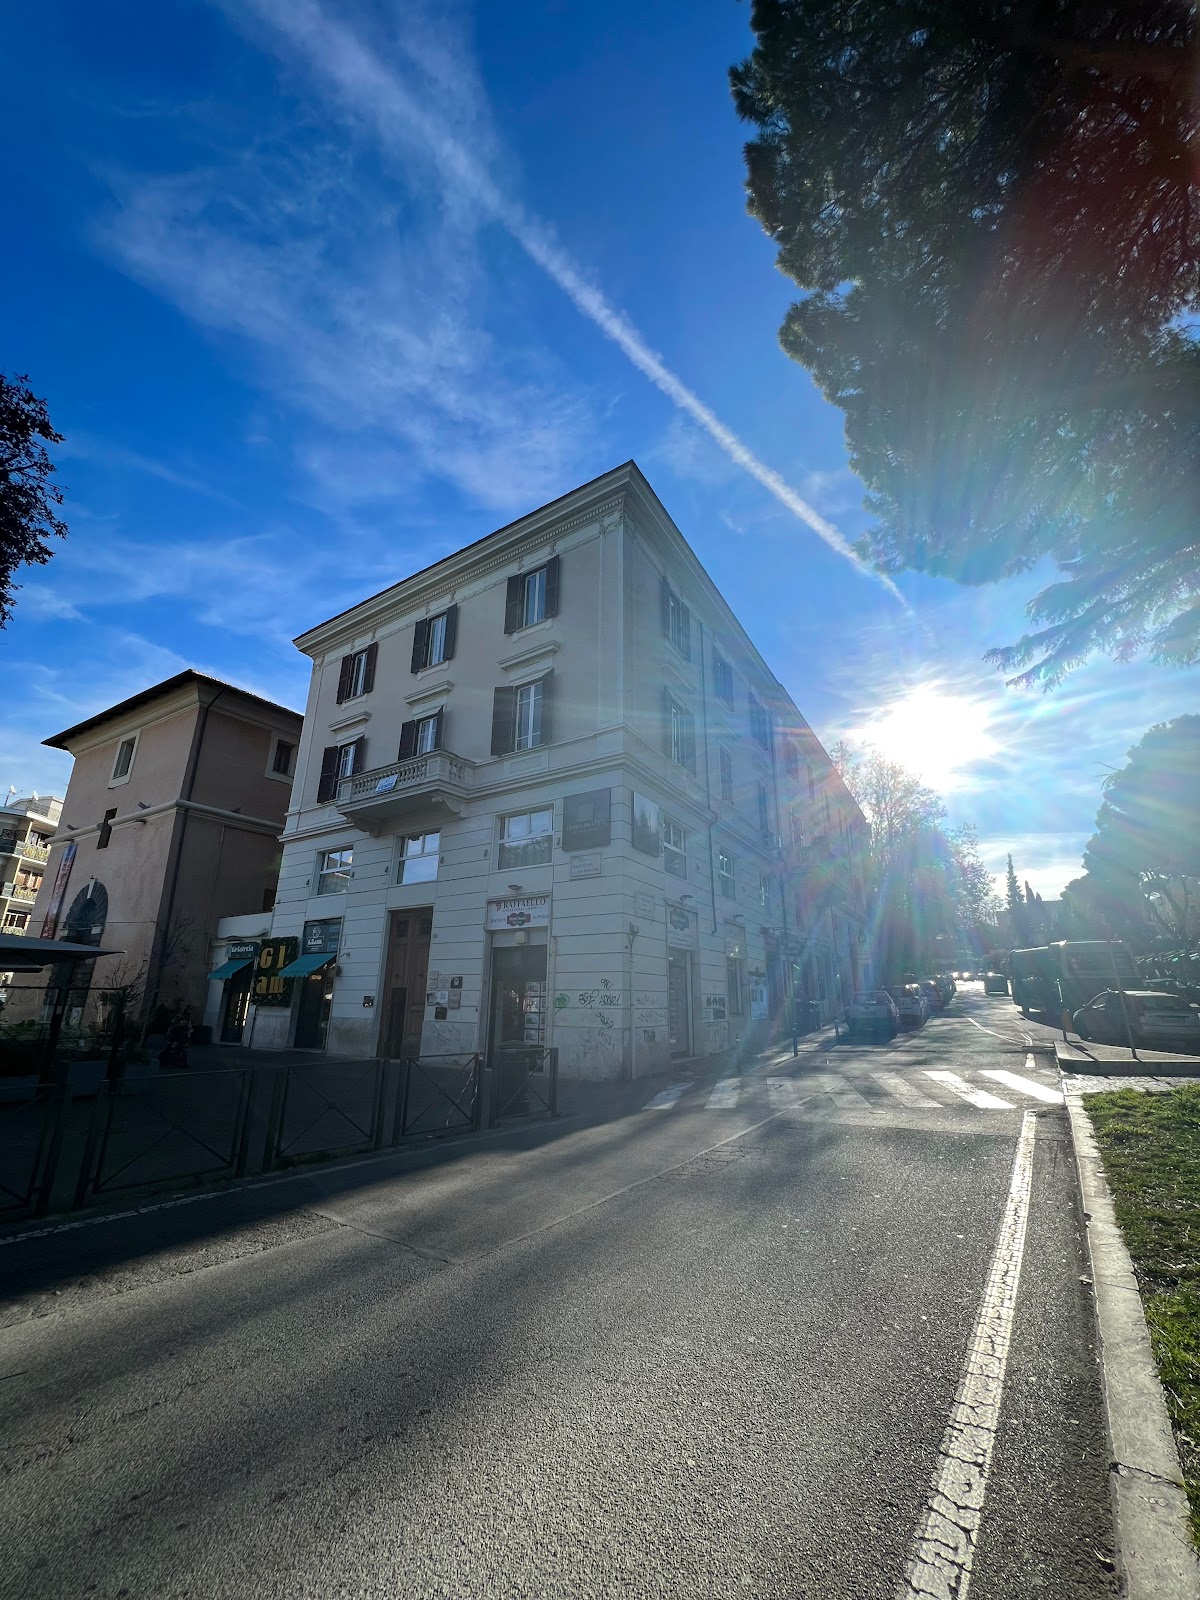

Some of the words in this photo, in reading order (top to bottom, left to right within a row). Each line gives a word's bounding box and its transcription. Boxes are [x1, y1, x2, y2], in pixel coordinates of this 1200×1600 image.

[503, 897, 546, 909] RAFFAELLO
[231, 944, 254, 953] Gelateria
[255, 975, 285, 994] am
